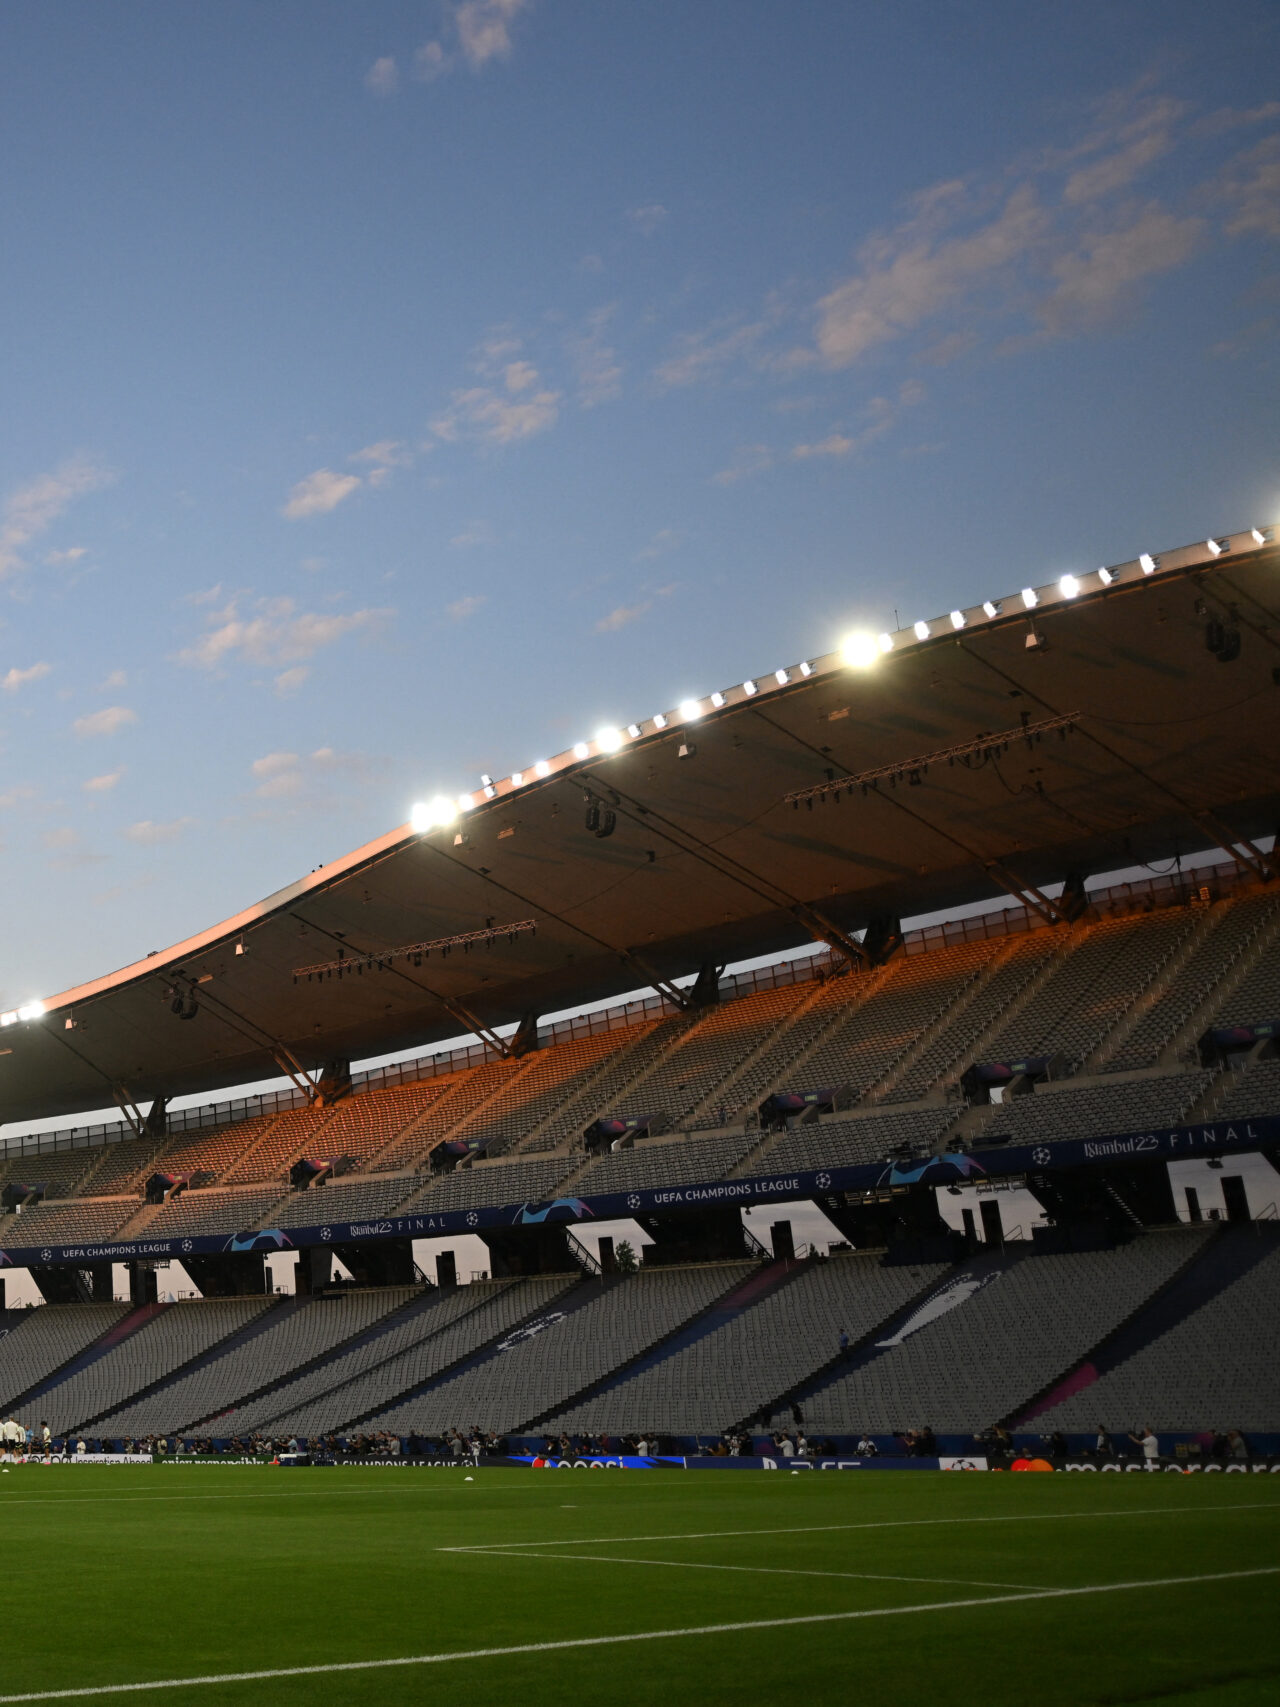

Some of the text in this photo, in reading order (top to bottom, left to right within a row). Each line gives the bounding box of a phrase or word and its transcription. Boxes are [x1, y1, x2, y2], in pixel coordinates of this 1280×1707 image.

[1170, 1124, 1257, 1147] FINAL
[654, 1178, 800, 1204] UEFA CHAMPIONS LEAGUE
[397, 1216, 447, 1231] FINAL
[62, 1242, 171, 1258] UEFA CHAMPIONS LEAGUE
